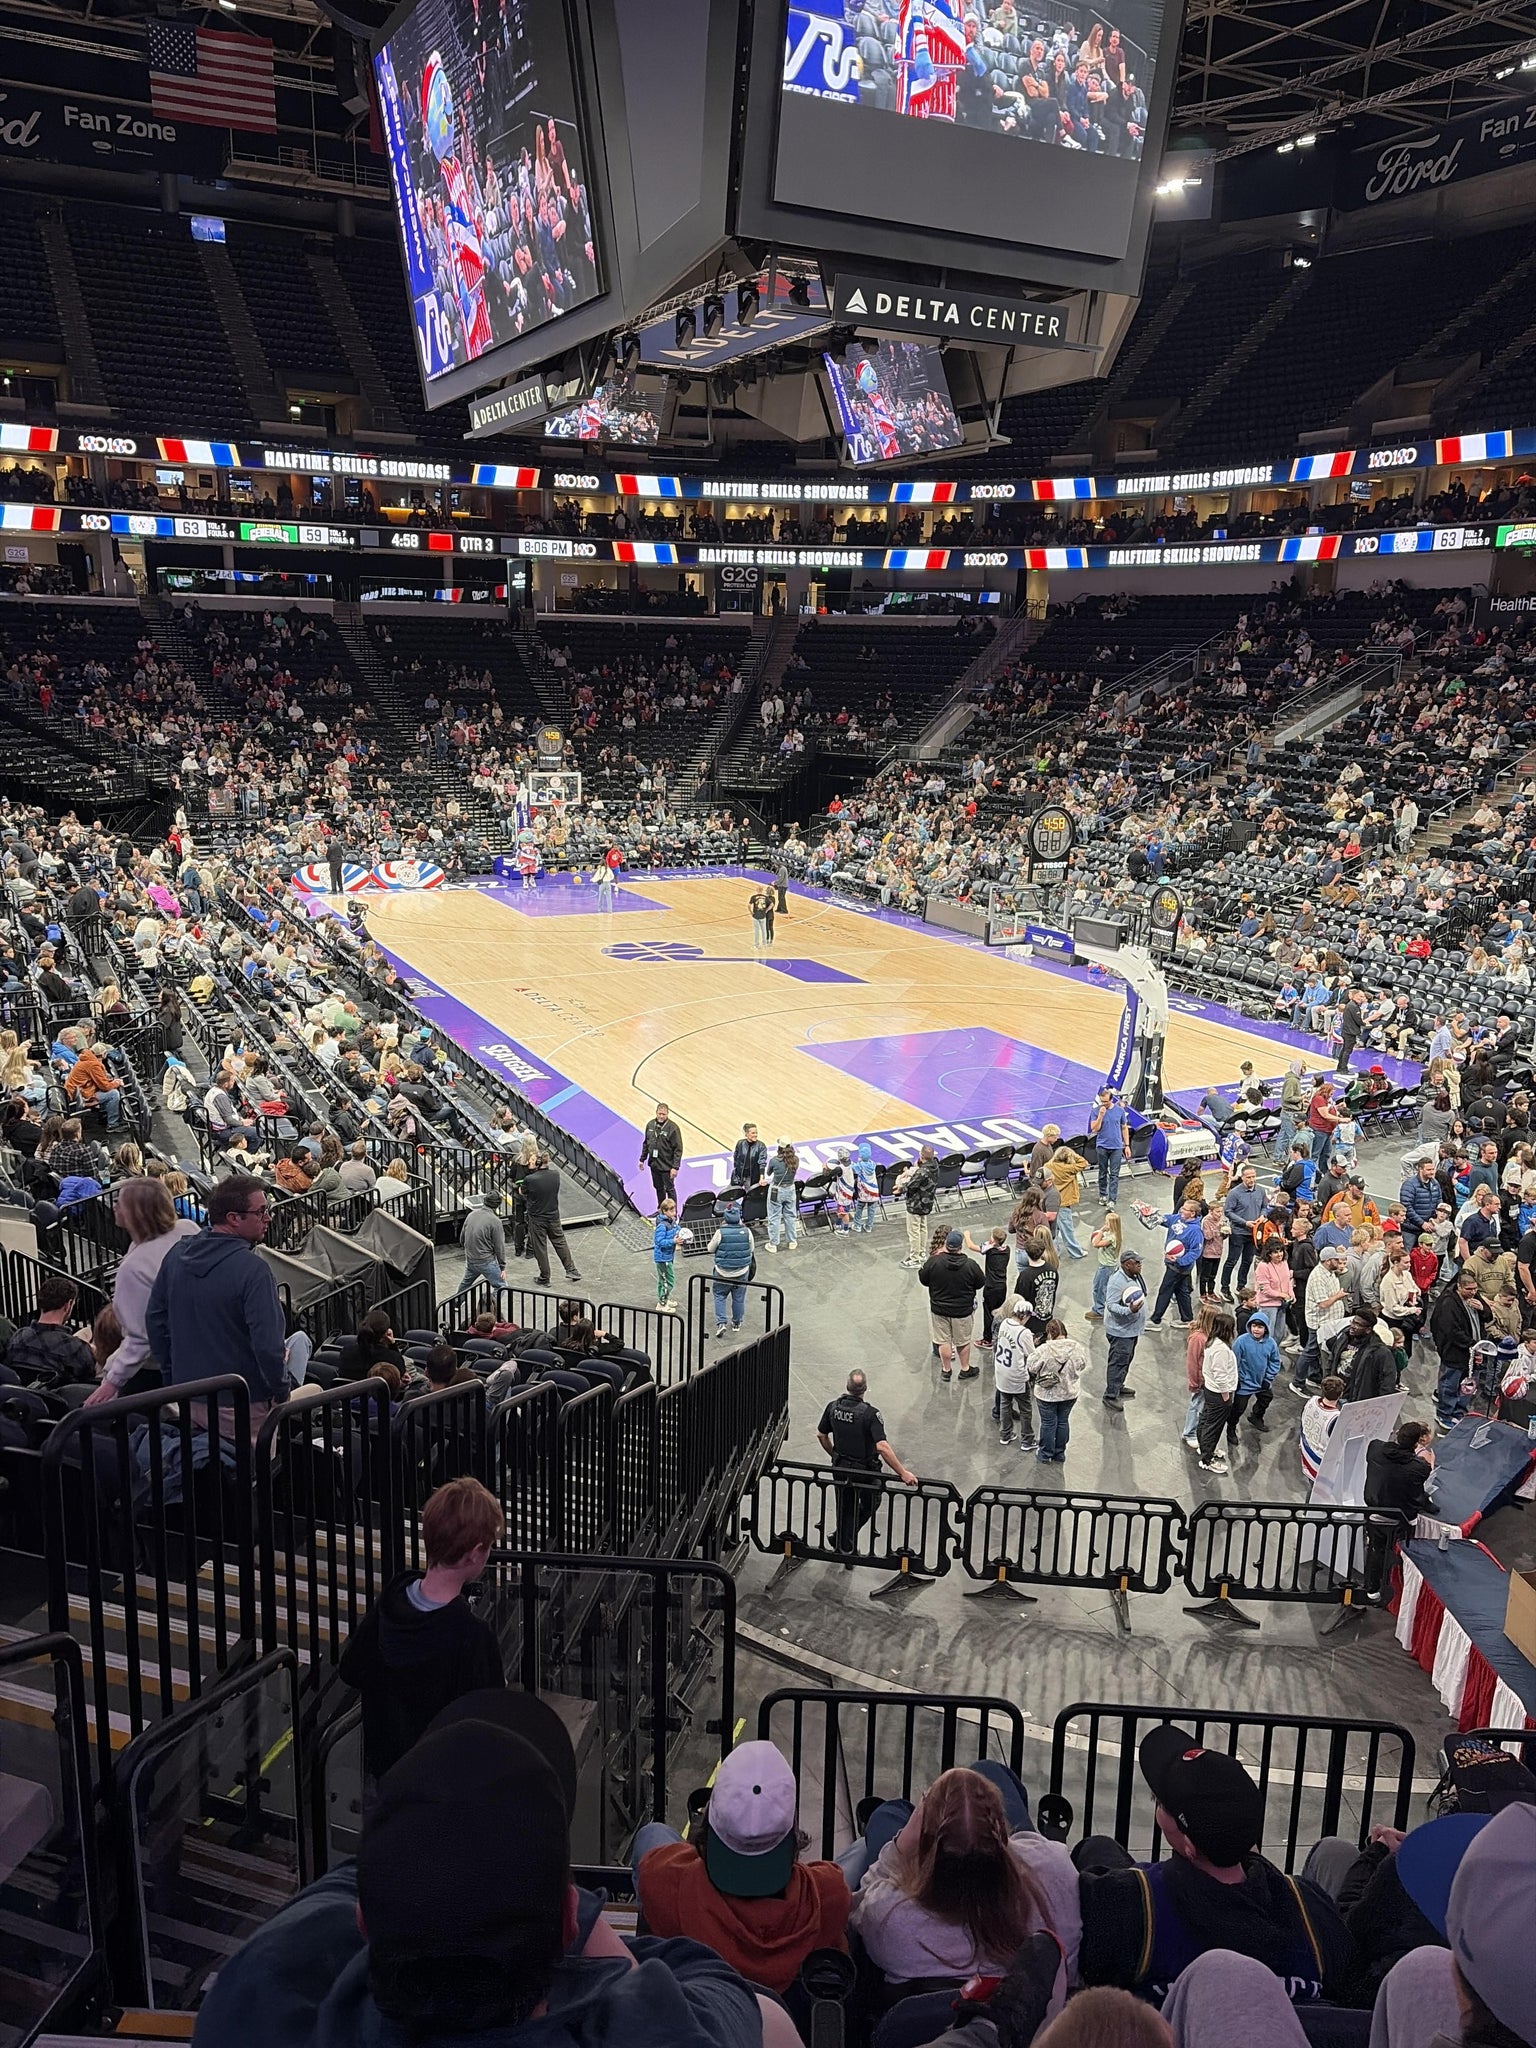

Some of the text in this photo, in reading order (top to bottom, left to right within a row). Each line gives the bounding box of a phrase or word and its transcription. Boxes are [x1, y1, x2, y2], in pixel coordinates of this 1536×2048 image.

[64, 105, 111, 132] Fan
[116, 114, 177, 142] Zone
[1480, 115, 1519, 142] Fan
[1366, 134, 1464, 201] Ford
[402, 150, 426, 274] AMERICA
[875, 293, 1060, 337] DELTA CENTER
[480, 385, 543, 426] DELTA CENTER
[264, 451, 451, 481] HALFTIME SKILLS SHOWCASE
[1117, 465, 1274, 495] HALFTIME SKILLS SHOWCASE
[702, 481, 869, 500] HALFTIME SKILLS SHOWCASE
[182, 521, 200, 535] 63
[220, 523, 227, 531] 7
[306, 529, 323, 542] 59
[341, 530, 347, 538] 7
[1478, 529, 1484, 538] 7
[391, 533, 419, 548] 4:58
[460, 537, 493, 552] QTR 3
[524, 541, 569, 555] 8:06 PM
[1440, 532, 1457, 547] 63
[7, 549, 26, 557] G2G
[698, 548, 864, 567] HALFTIME SKILLS SHOWCASE
[1108, 545, 1262, 565] HALFTIME SKILLS SHOWCASE
[562, 574, 577, 582] G2G
[721, 567, 759, 583] G2G
[1044, 817, 1066, 830] 4:58
[1043, 861, 1068, 869] TISSOT
[524, 992, 565, 1013] DELTA
[561, 1011, 605, 1038] CENTER
[1113, 1006, 1133, 1082] AMERICA FIRST
[479, 1044, 552, 1082] SEATGEEK
[866, 1118, 1043, 1160] UTAH
[996, 1344, 1013, 1368] 23
[834, 1409, 854, 1423] POLICE
